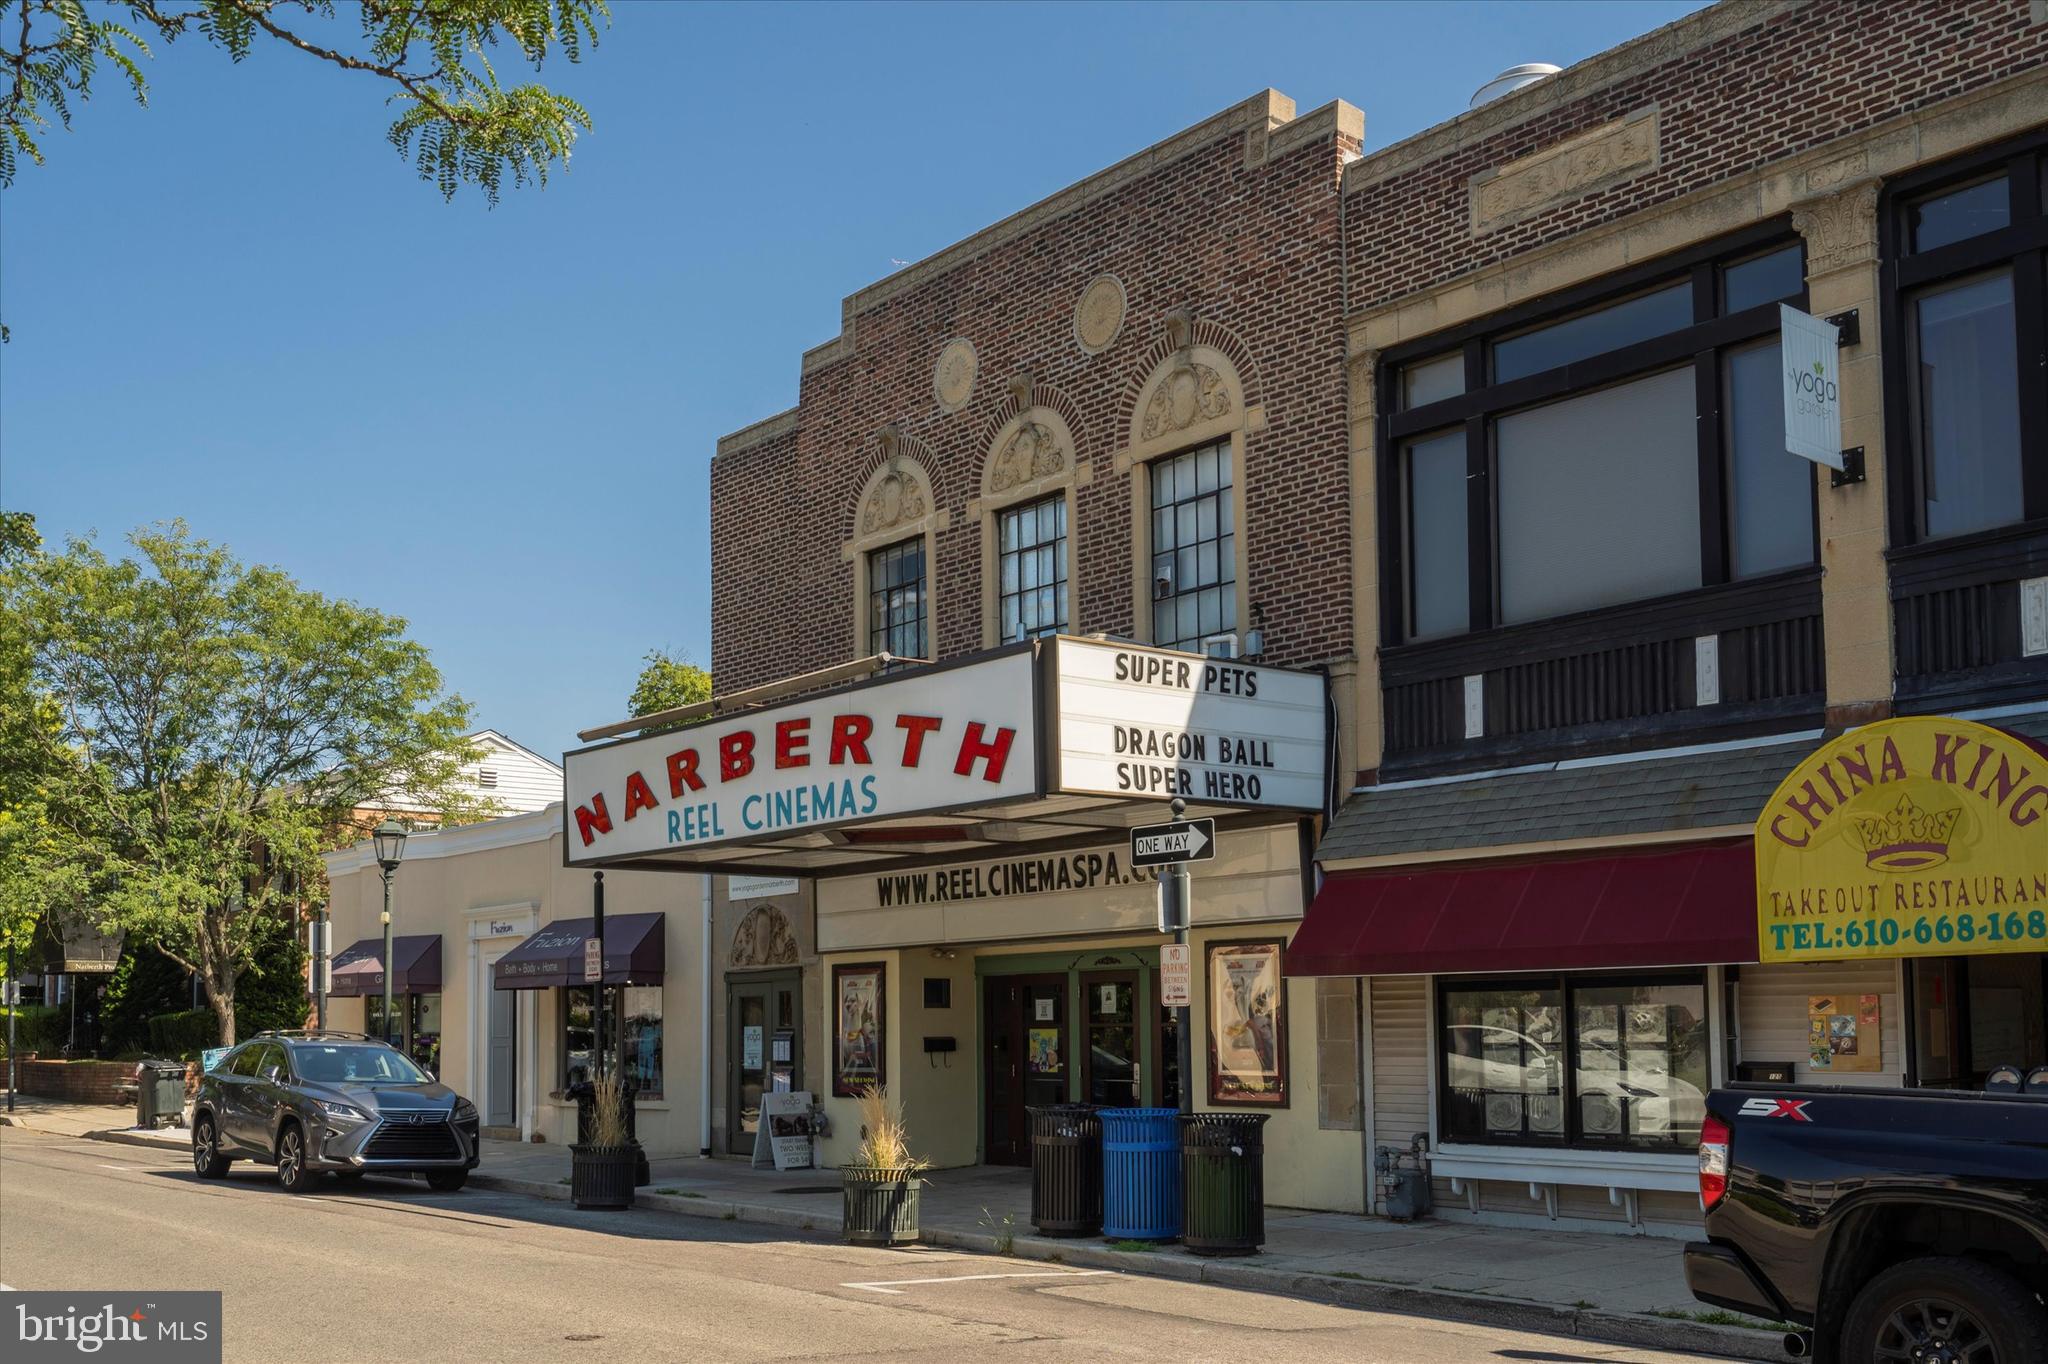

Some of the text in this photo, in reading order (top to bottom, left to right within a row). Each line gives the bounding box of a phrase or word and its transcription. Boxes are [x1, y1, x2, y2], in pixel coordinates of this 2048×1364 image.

[1793, 367, 1836, 403] yoga
[1115, 652, 1257, 697] SUPER PETS
[1114, 725, 1274, 767] DRAGON BALL
[574, 714, 1016, 847] NARBERTH
[1117, 762, 1261, 800] SUPER HERO
[1770, 732, 2048, 847] CHINA KING
[667, 775, 878, 843] REEL CINEMAS
[1137, 834, 1189, 854] ONE WAY
[490, 921, 513, 935] Fuzion
[525, 932, 581, 950] Fuzion
[1169, 948, 1180, 960] NO
[1162, 963, 1188, 974] PARKING
[1162, 976, 1188, 984] BETWEEN
[1168, 984, 1184, 992] SIGNS
